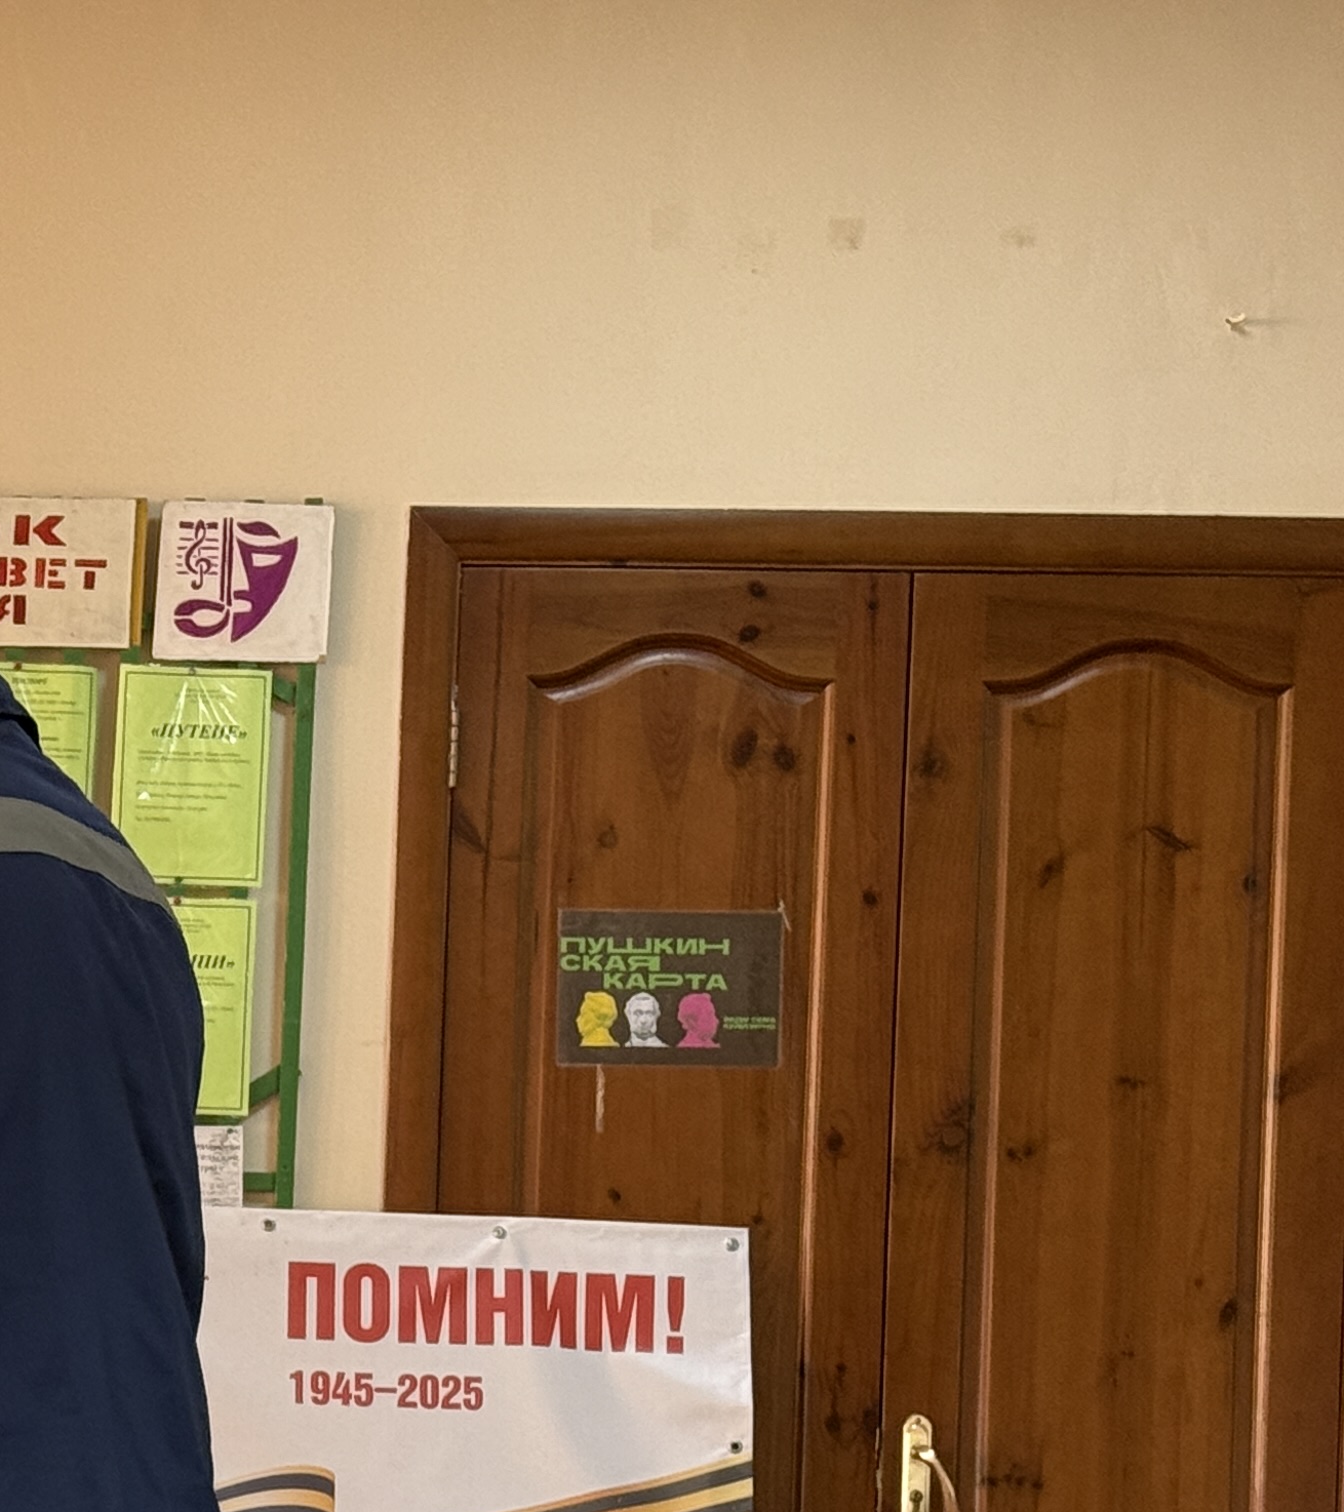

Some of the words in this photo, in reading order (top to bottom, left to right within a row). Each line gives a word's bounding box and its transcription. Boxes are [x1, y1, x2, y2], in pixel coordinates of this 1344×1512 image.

[560, 936, 730, 955] ПУШКИН
[560, 955, 661, 971] СКАЯ
[603, 973, 728, 990] КАРТА
[286, 1261, 686, 1355] ПОМНИМ!
